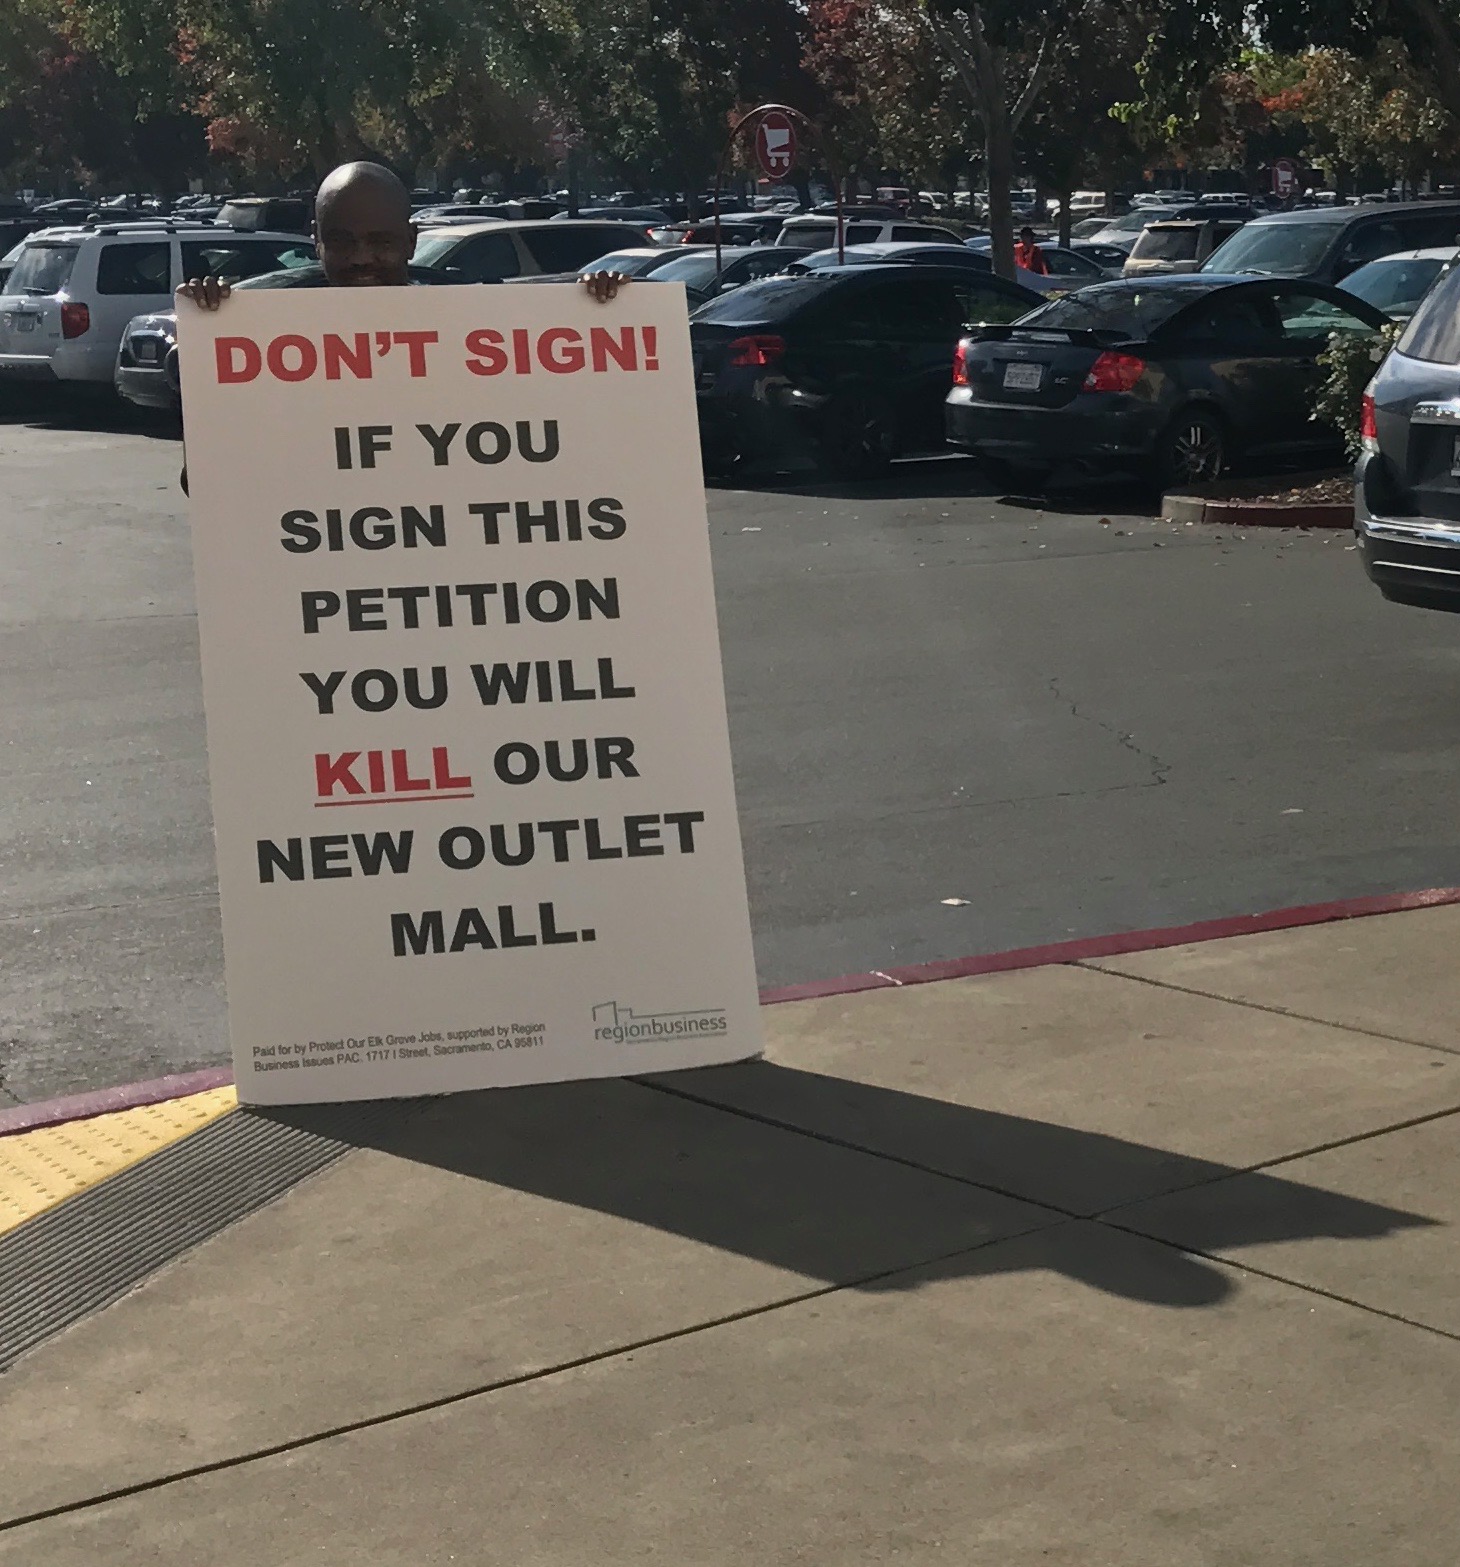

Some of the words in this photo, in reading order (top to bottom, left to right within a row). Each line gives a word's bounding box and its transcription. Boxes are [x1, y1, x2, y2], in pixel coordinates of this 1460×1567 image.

[215, 331, 438, 383] DON'T
[466, 326, 659, 376] SIGN!
[334, 425, 393, 469] IF
[415, 420, 559, 466] YOU
[281, 505, 446, 553] SIGN
[468, 498, 626, 545] THIS
[301, 578, 620, 634] PETITION
[299, 666, 448, 714] YOU
[470, 658, 636, 705] WILL
[315, 747, 473, 797] KILL
[494, 737, 640, 785] OUR
[257, 830, 414, 883] NEW
[439, 811, 704, 870] OUTLET
[391, 902, 596, 957] MALL.
[253, 1046, 275, 1057] Paid
[278, 1045, 291, 1055] for
[294, 1044, 306, 1055] by
[309, 1040, 344, 1052] Protect
[347, 1038, 366, 1049] Our
[368, 1036, 383, 1047] Elk
[386, 1034, 415, 1046] Grove
[418, 1031, 444, 1043] Jobs,
[447, 1026, 494, 1041] supported
[497, 1026, 509, 1037] by
[511, 1023, 545, 1035] Region
[254, 1060, 299, 1072] Business
[303, 1057, 334, 1067] Issues
[366, 1050, 389, 1061] 1717
[433, 1042, 494, 1056] Sacramento,
[497, 1038, 512, 1050] CA
[514, 1036, 544, 1048] 95811
[595, 1016, 727, 1043] regionbusiness
